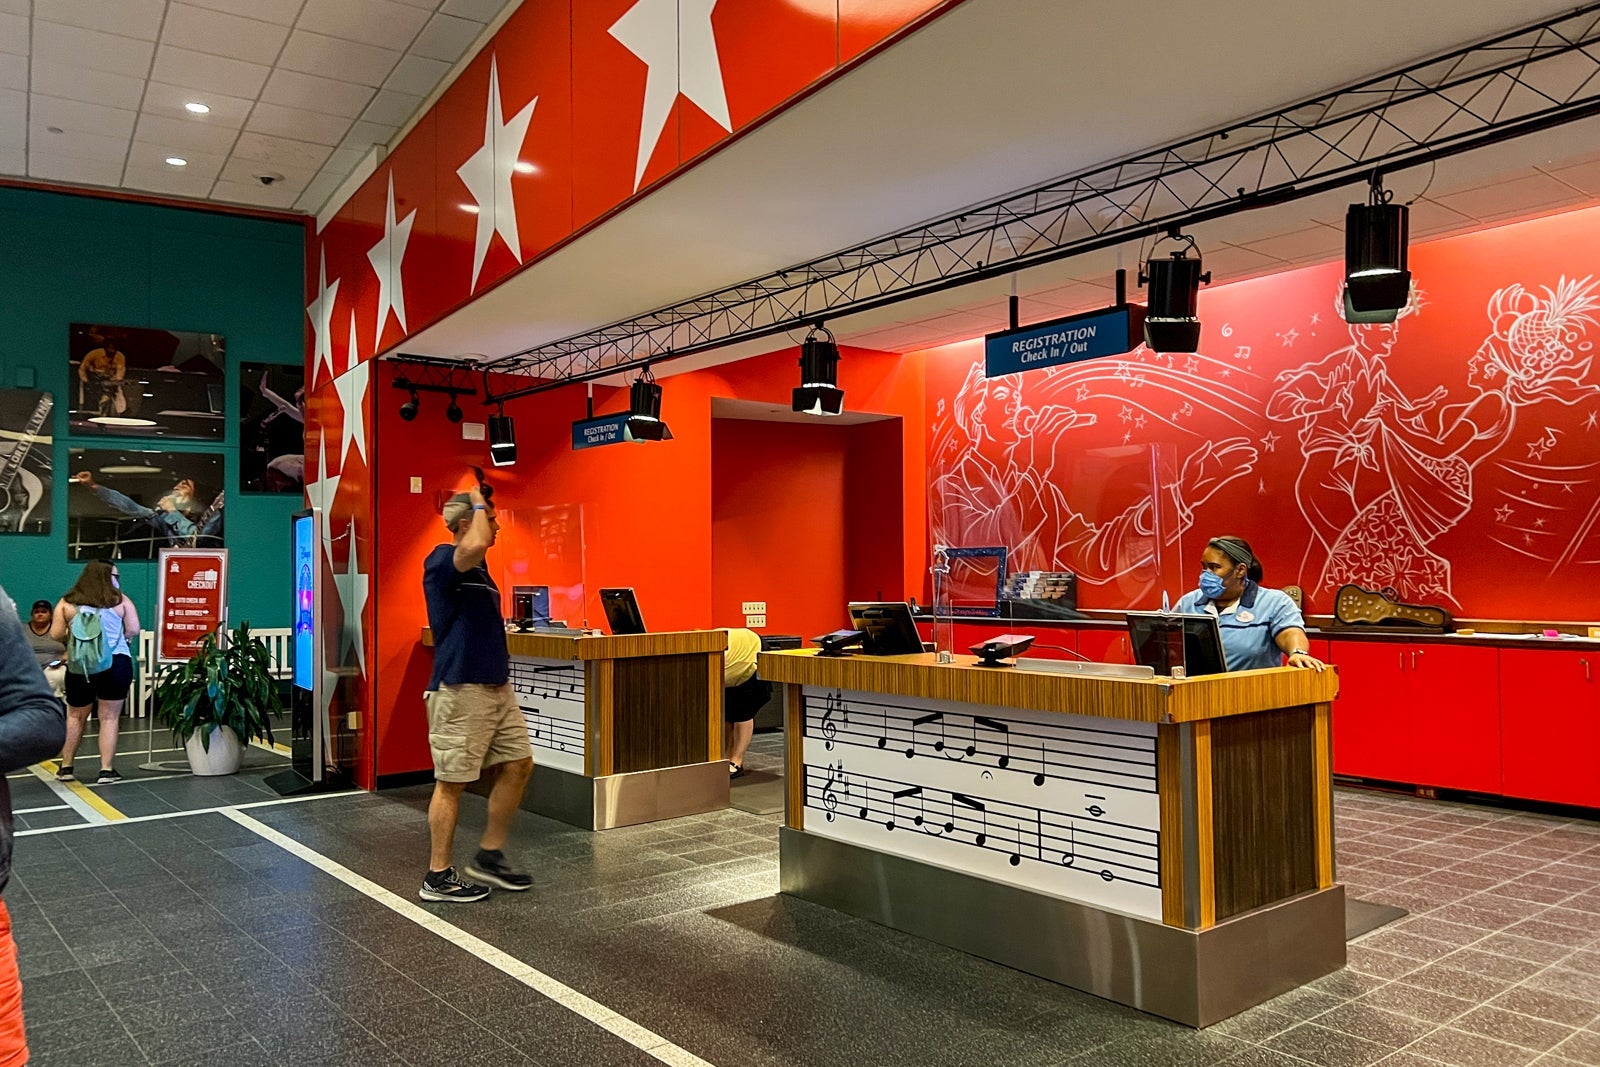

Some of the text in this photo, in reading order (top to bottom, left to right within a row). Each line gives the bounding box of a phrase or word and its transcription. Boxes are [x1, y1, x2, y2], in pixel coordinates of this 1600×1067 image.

[1012, 326, 1097, 353] REGISTRATION
[1021, 341, 1088, 363] Check In / Out
[584, 423, 619, 436] REGISTRATION
[187, 580, 217, 590] CHECKOUT
